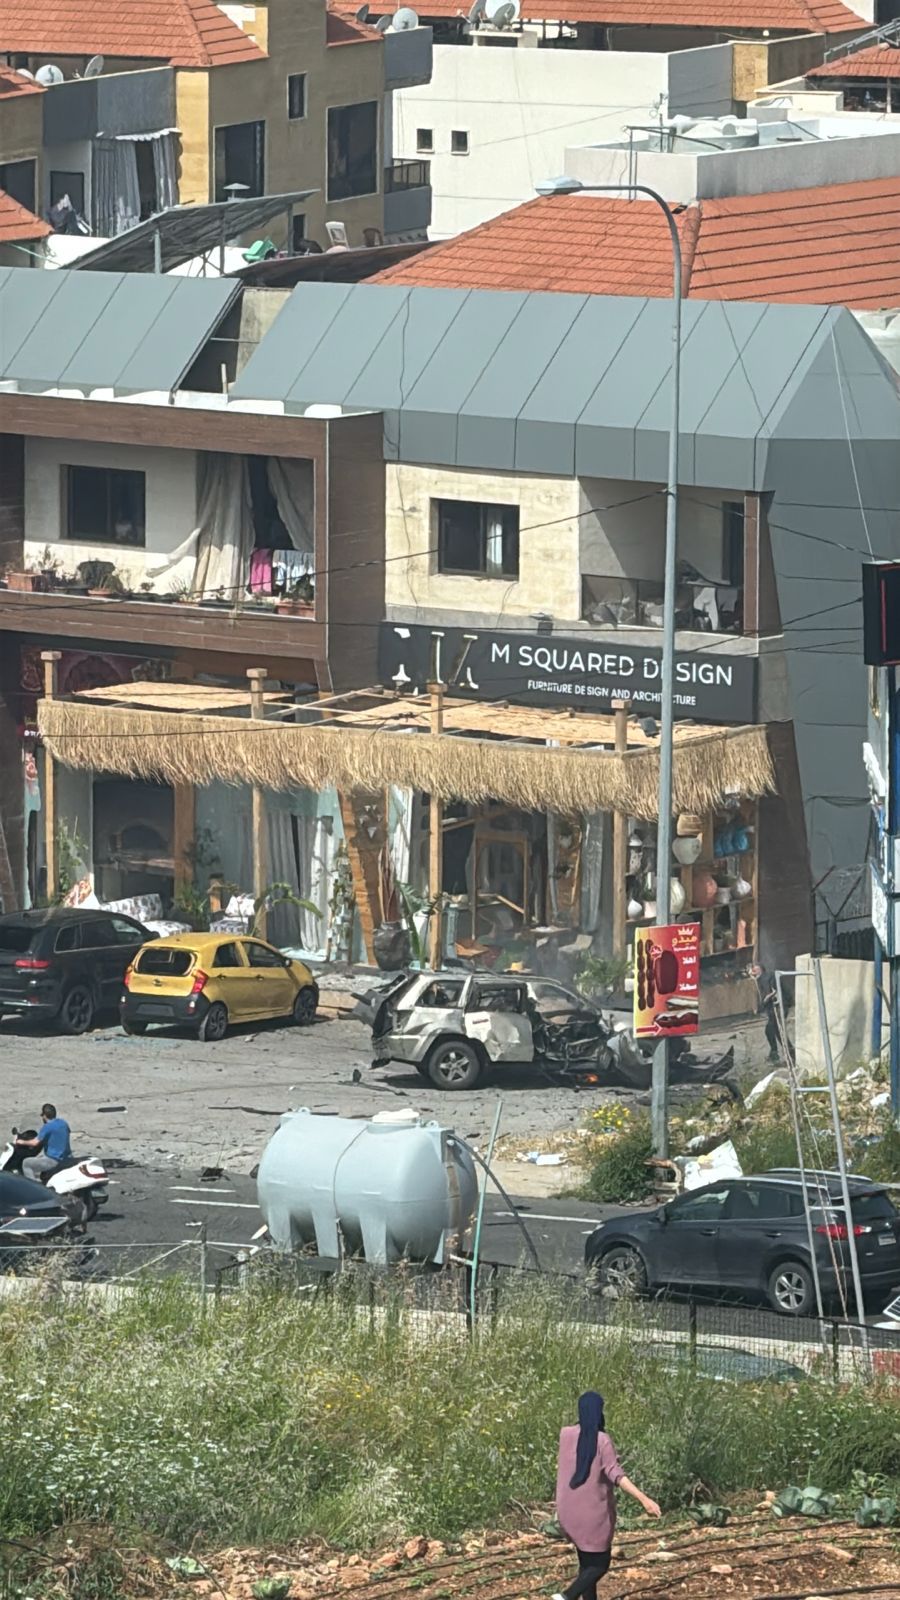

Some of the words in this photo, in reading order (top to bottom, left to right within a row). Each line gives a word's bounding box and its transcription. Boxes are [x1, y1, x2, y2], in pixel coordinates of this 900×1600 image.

[491, 643, 510, 664] M
[518, 645, 634, 677] SQUARED
[643, 658, 733, 686] DSIGN
[527, 679, 573, 694] FURNITURE
[574, 685, 609, 697] DESIGN
[611, 688, 631, 699] AND
